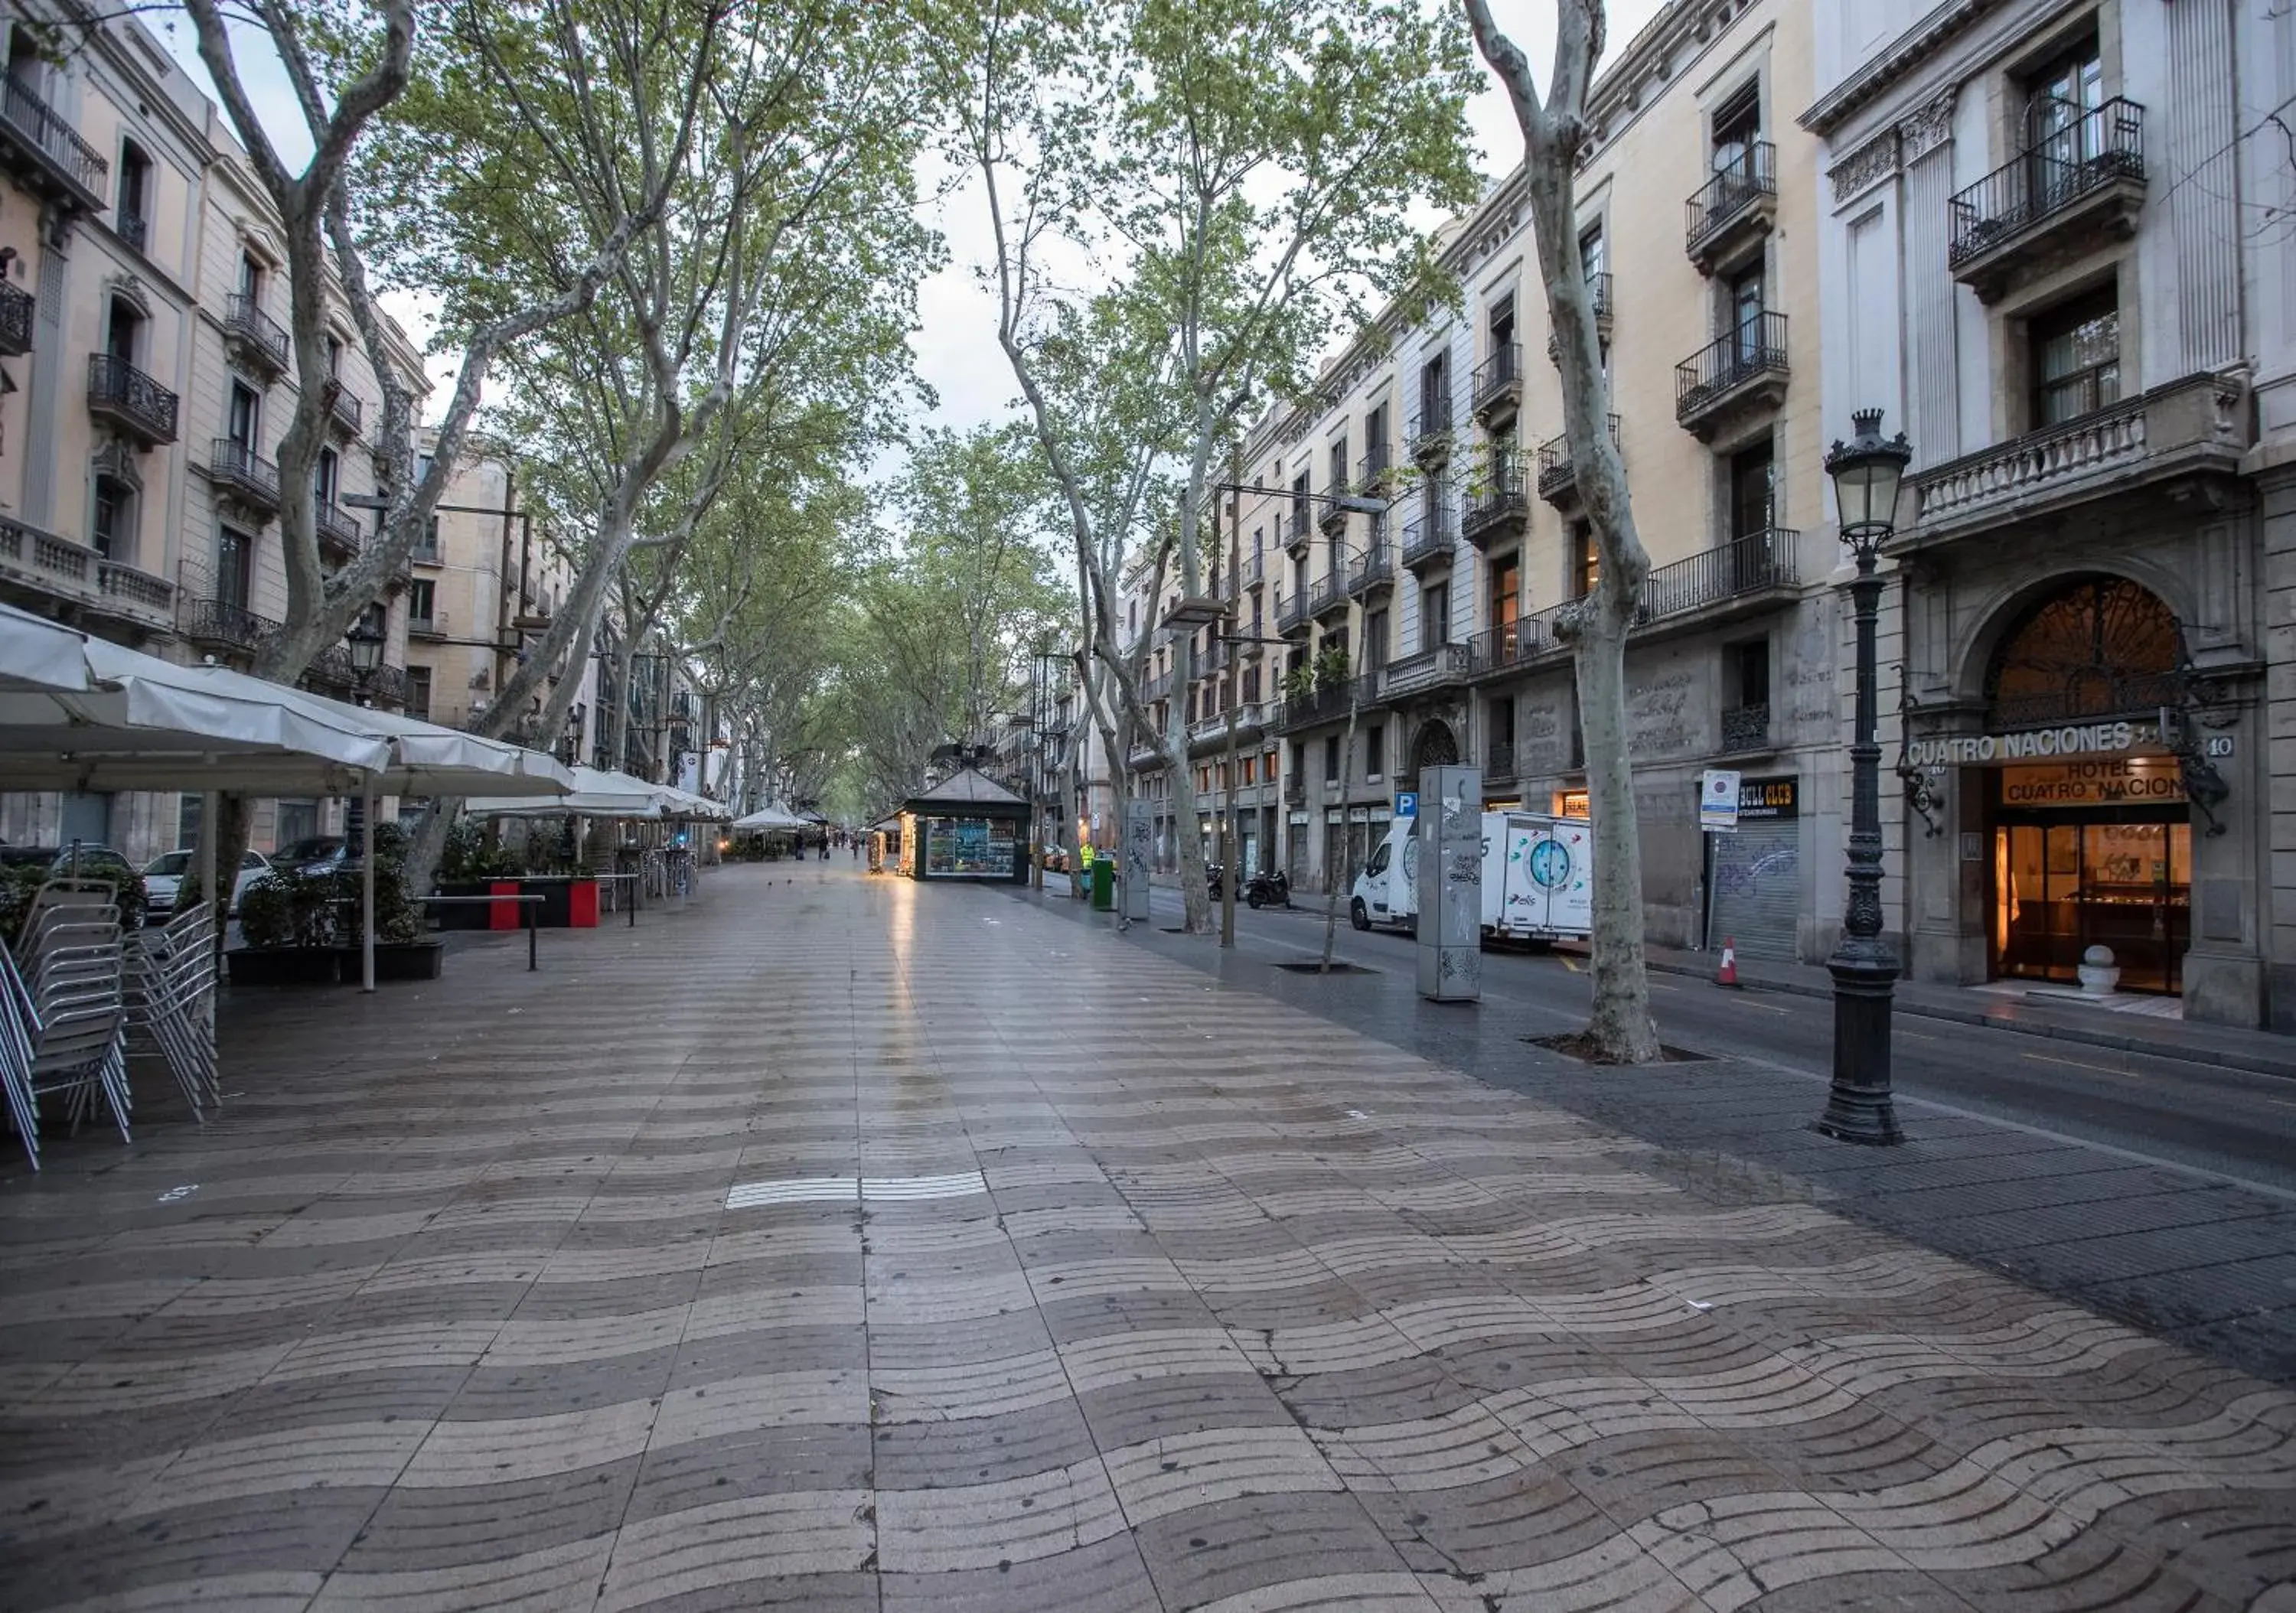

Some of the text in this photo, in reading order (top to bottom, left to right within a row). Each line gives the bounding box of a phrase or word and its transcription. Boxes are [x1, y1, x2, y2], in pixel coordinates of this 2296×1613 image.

[1907, 722, 2134, 766] CUATRO NACIONES
[2208, 736, 2232, 756] 40
[2068, 760, 2135, 779] HOTEL
[1766, 783, 1792, 806] CLUB
[2007, 780, 2086, 801] CUATRO
[1400, 796, 1413, 813] P
